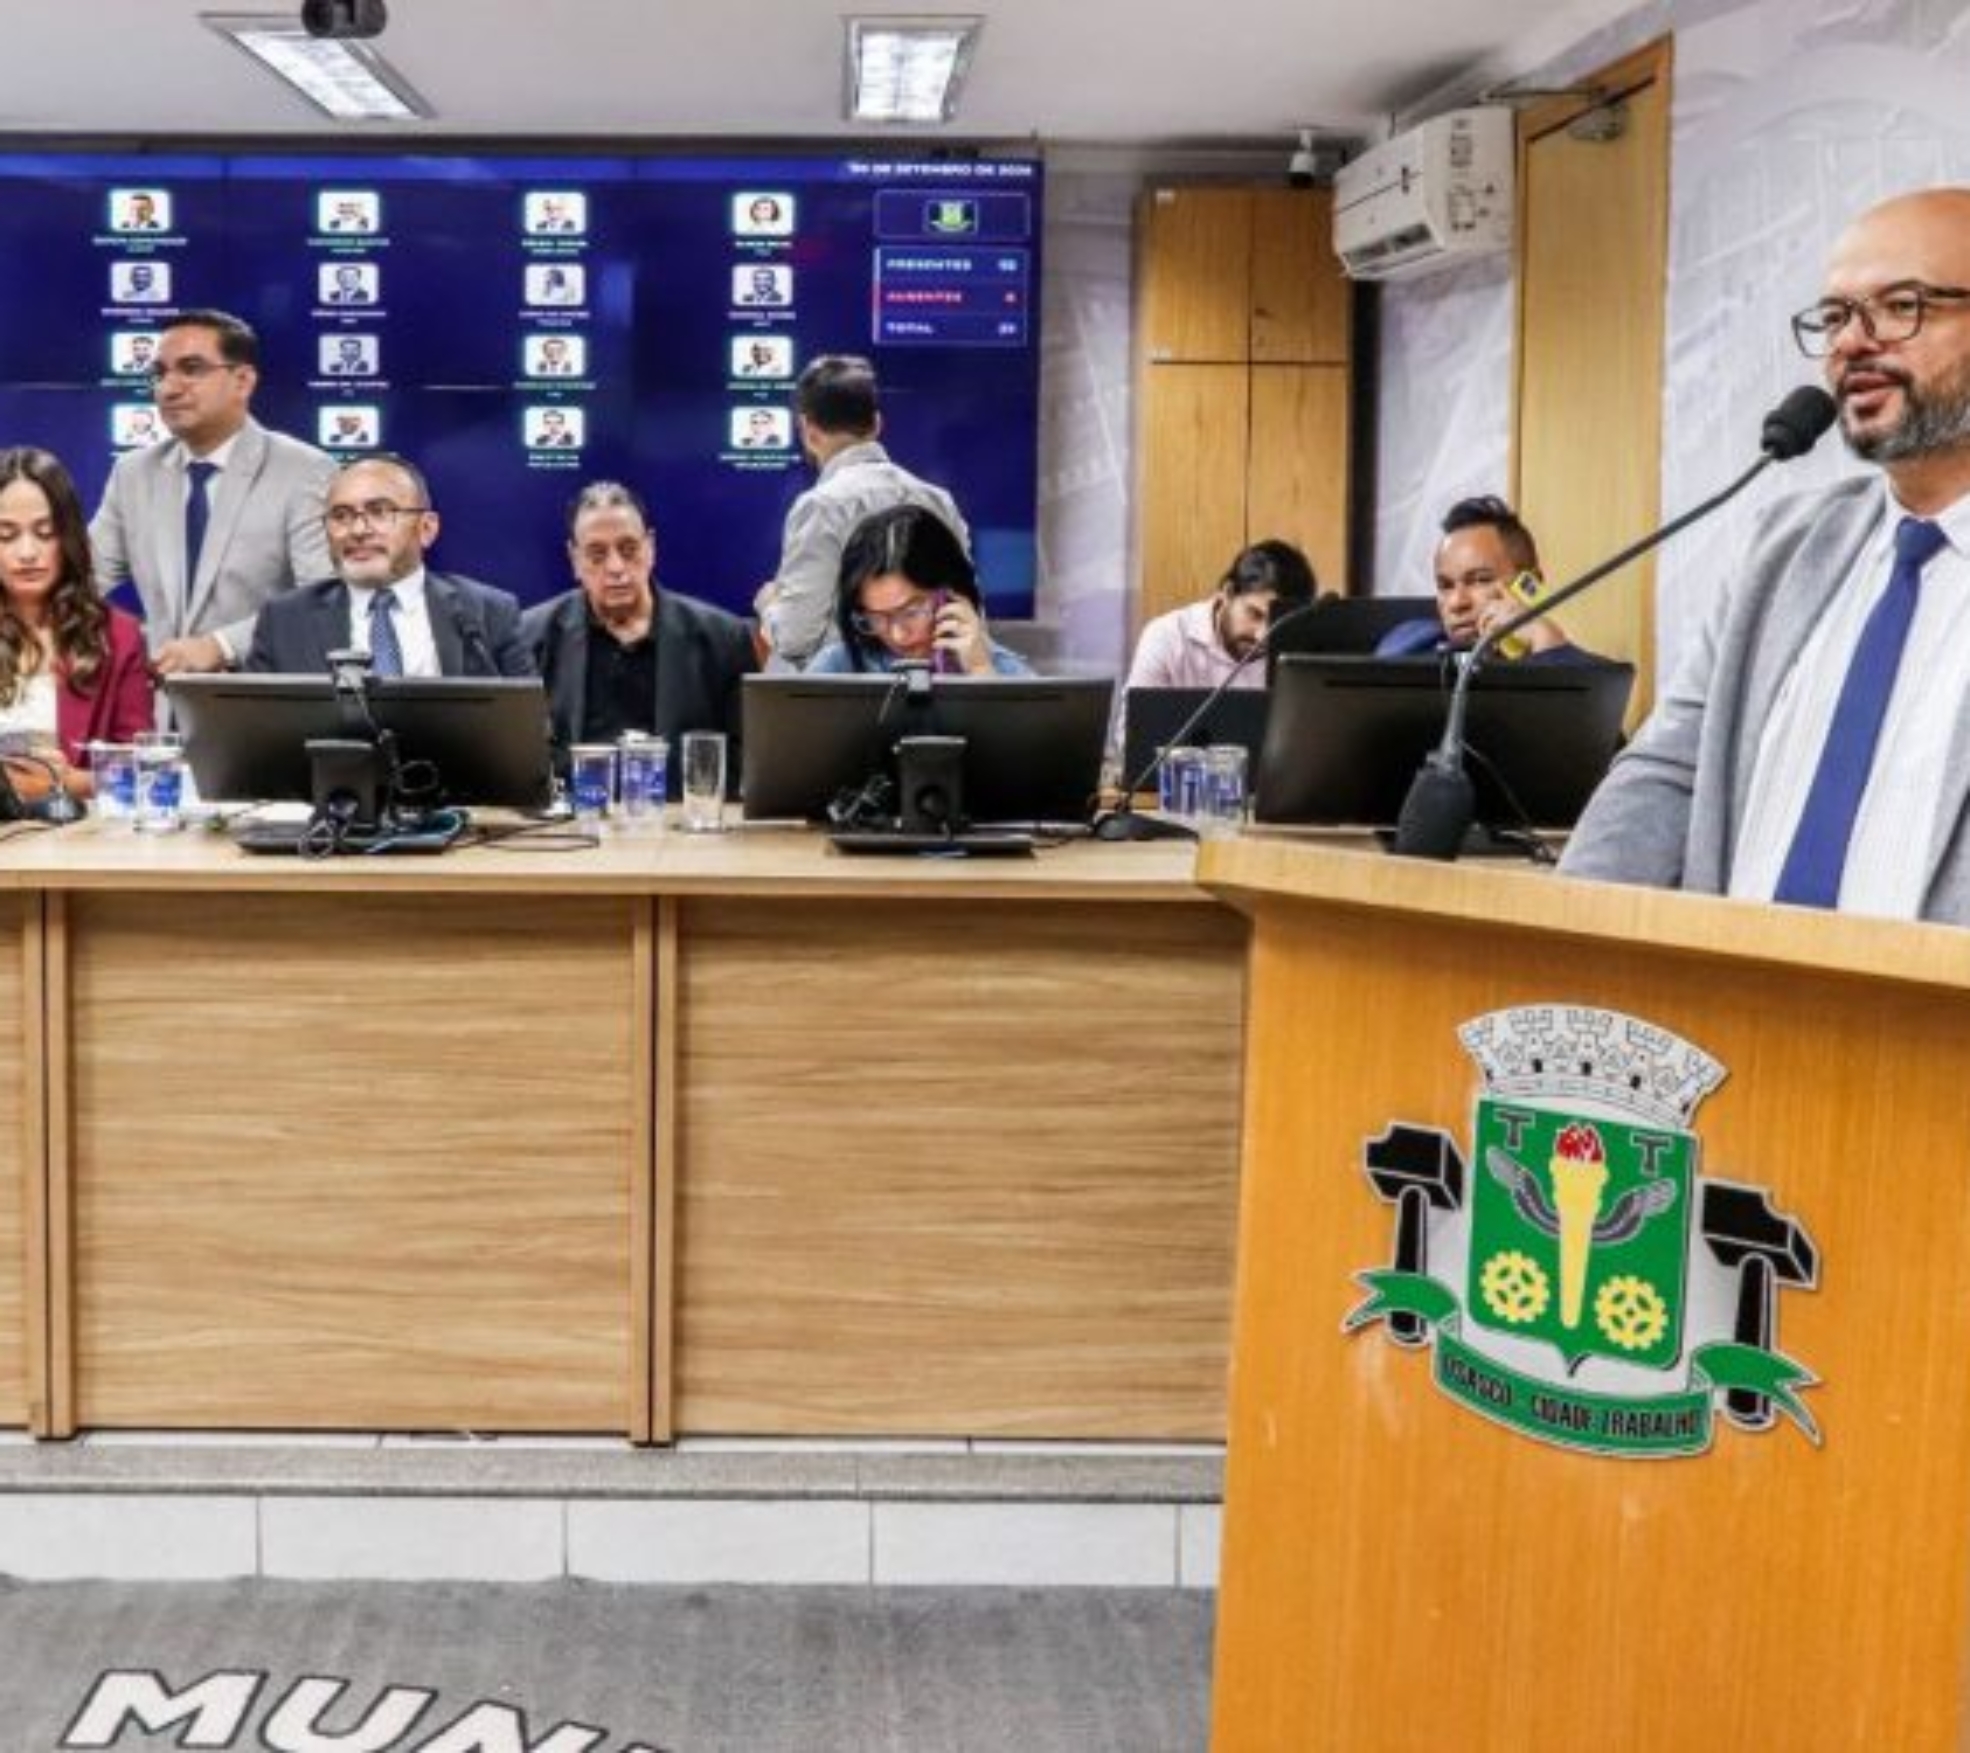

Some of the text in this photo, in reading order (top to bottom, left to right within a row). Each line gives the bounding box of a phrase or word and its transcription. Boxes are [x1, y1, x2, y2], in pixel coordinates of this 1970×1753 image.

[1495, 1109, 1534, 1149] T
[1632, 1132, 1672, 1174] T
[1531, 1394, 1593, 1431] CIDADE
[57, 1669, 670, 1753] MUN
